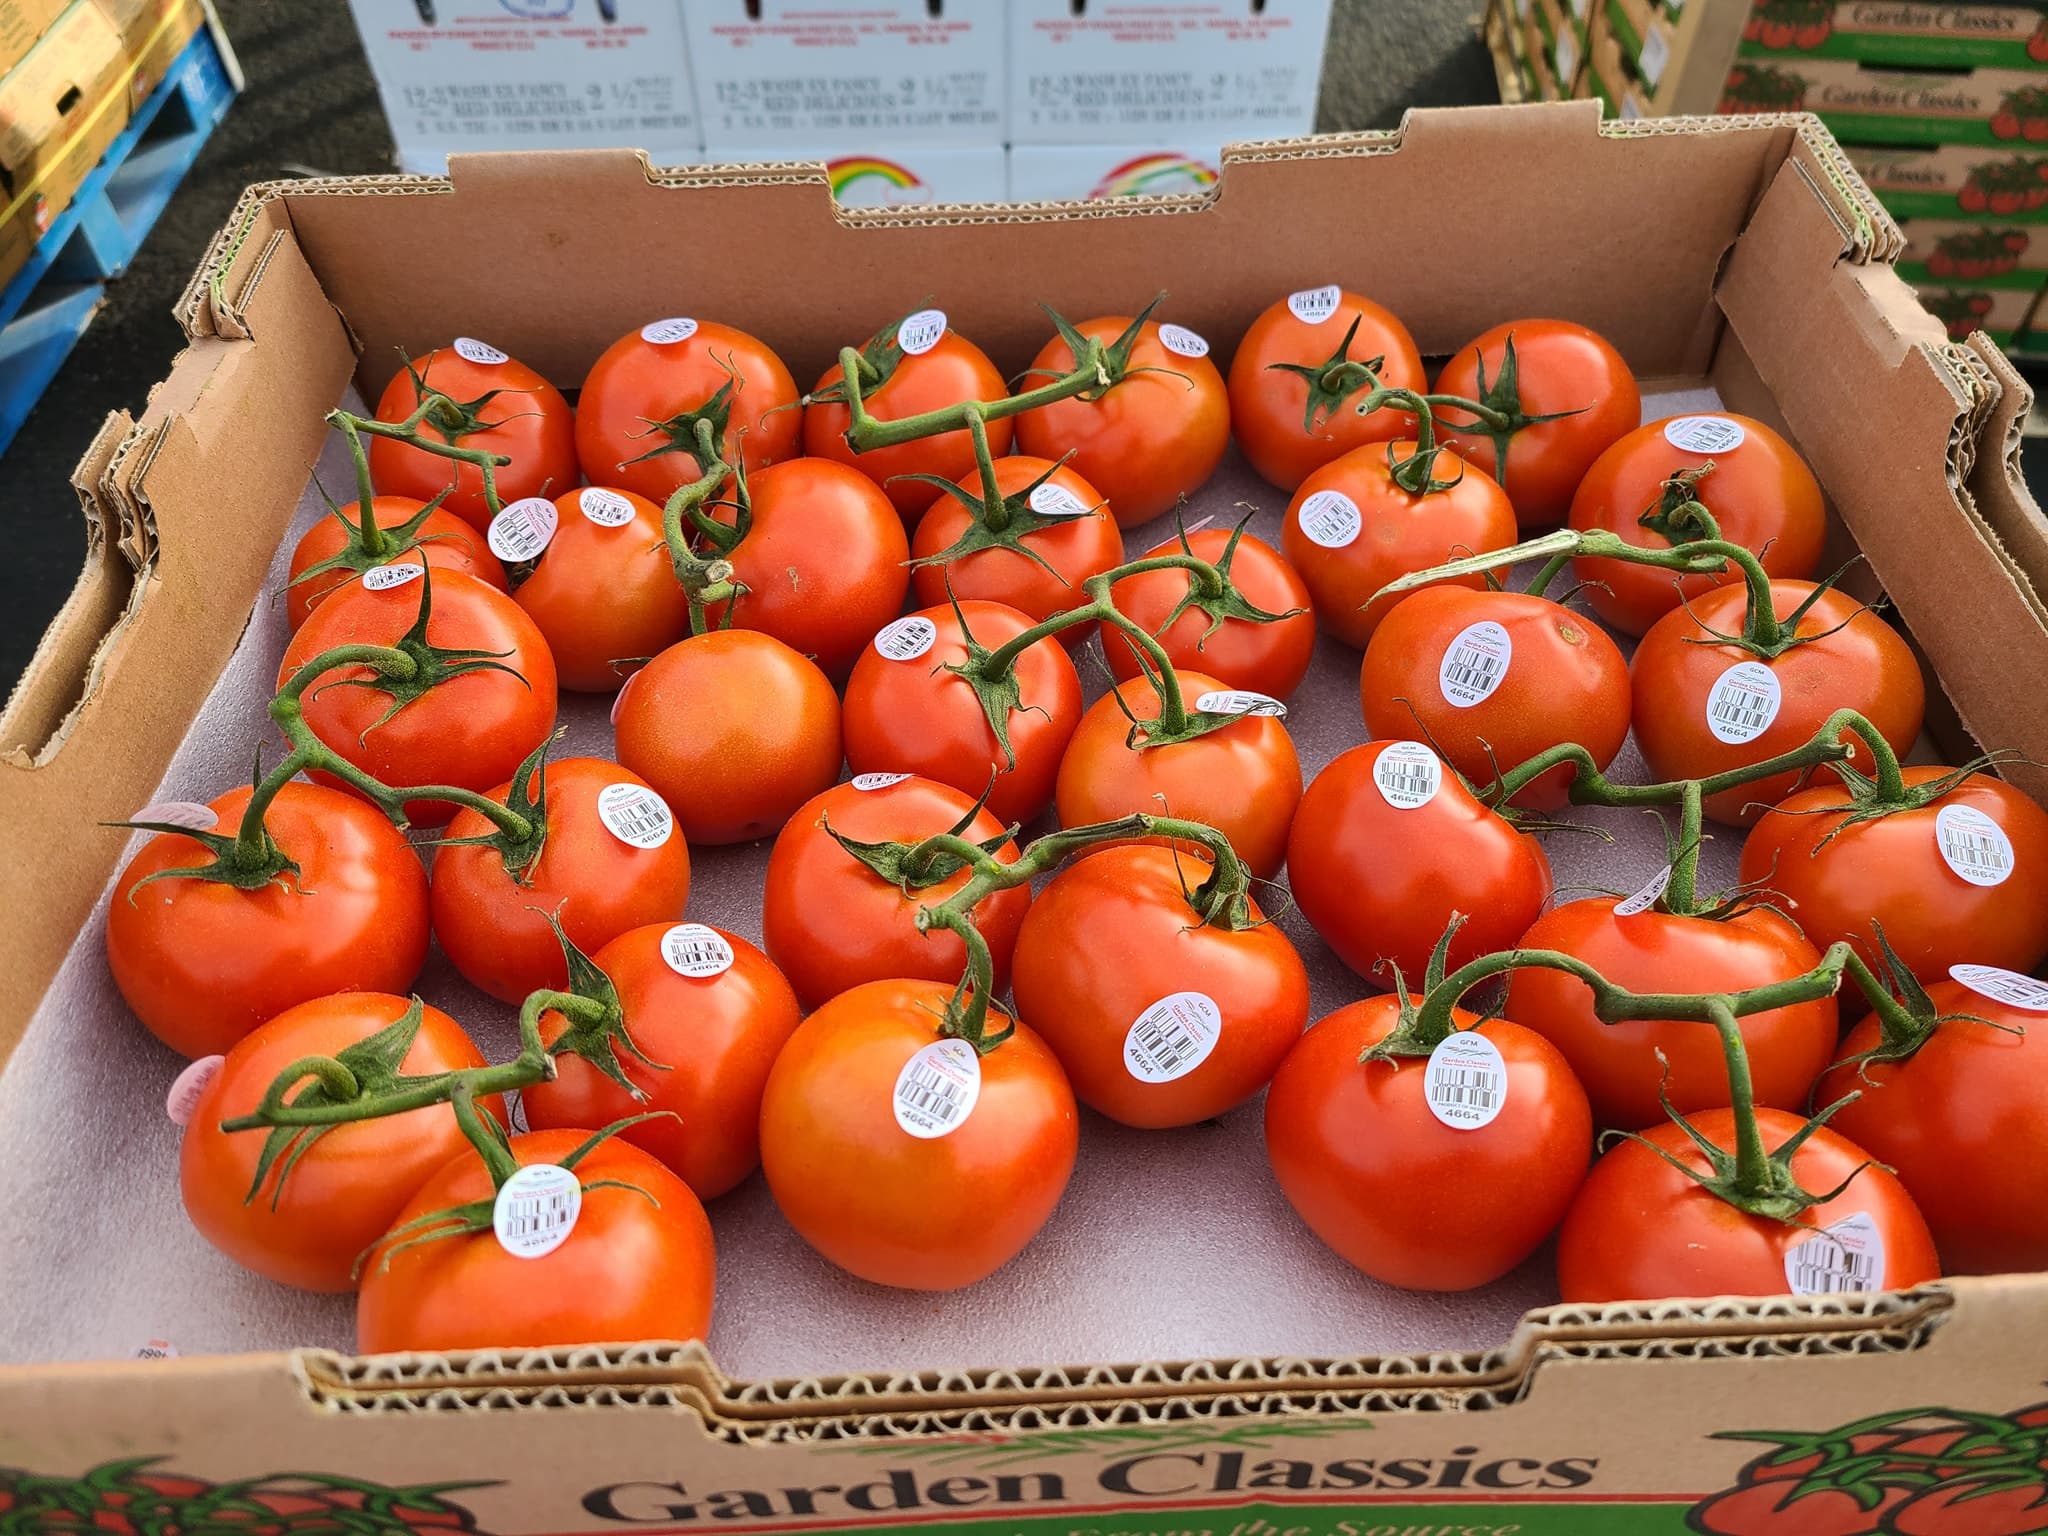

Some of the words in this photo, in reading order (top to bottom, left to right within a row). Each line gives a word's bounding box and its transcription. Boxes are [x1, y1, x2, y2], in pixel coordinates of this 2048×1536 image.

[1484, 627, 1499, 636] GCM
[1749, 666, 1765, 675] GCM
[1450, 688, 1476, 701] 4664
[1719, 726, 1748, 738] 4664
[1390, 794, 1419, 804] 4664
[641, 829, 666, 844] 4664
[1963, 868, 1997, 880] 4664
[1173, 1004, 1190, 1023] Garden
[1460, 1039, 1478, 1047] GCM
[1130, 1048, 1153, 1074] 4664
[1442, 1056, 1464, 1065] Garden
[1466, 1059, 1491, 1068] Classics
[902, 1110, 933, 1129] 4664
[1445, 1108, 1481, 1121] 4664
[581, 1469, 1069, 1522] Garden
[1099, 1446, 1600, 1497] Classics
